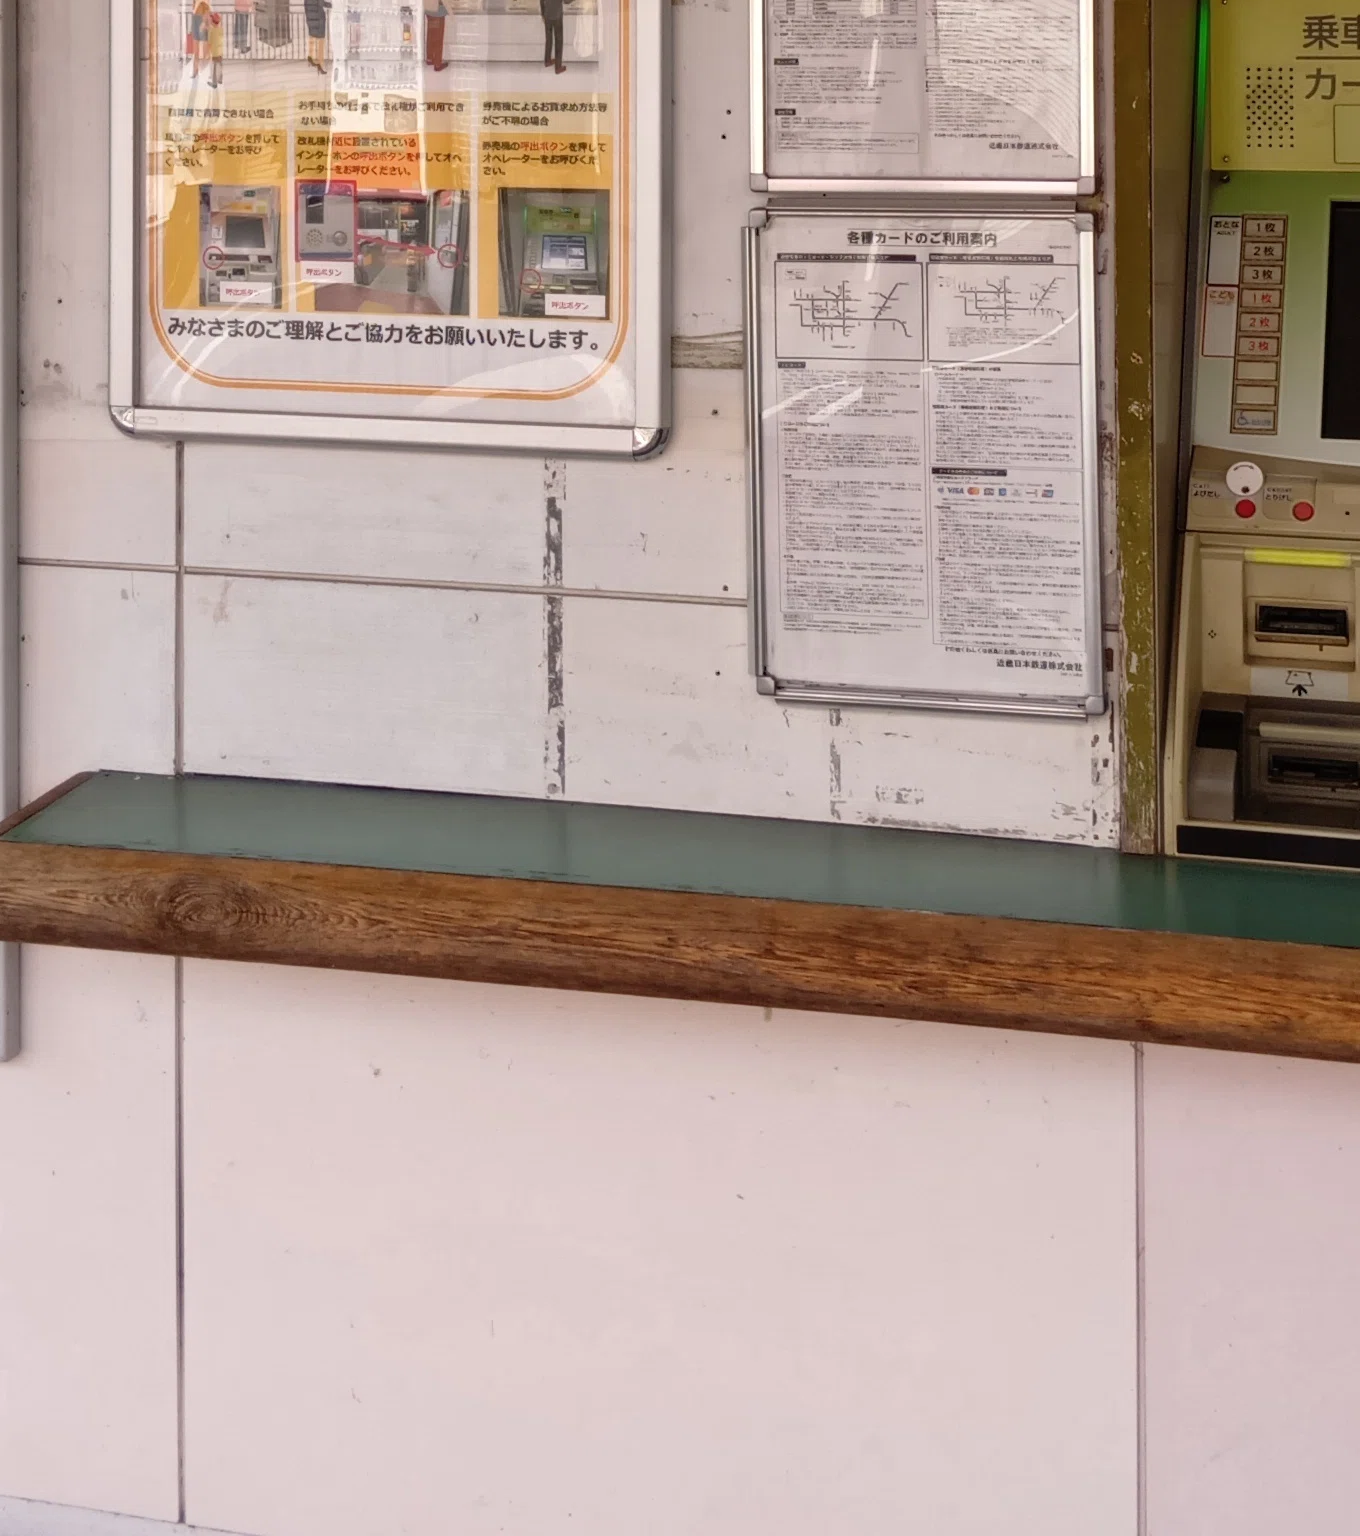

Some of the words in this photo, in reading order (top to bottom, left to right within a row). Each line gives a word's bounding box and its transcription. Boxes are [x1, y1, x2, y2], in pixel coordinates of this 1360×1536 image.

[1213, 221, 1240, 229] おとな
[847, 230, 997, 246] 各種カードのご利用案内
[168, 317, 599, 350] みなさまのご理解とご協力をお願いいたします。
